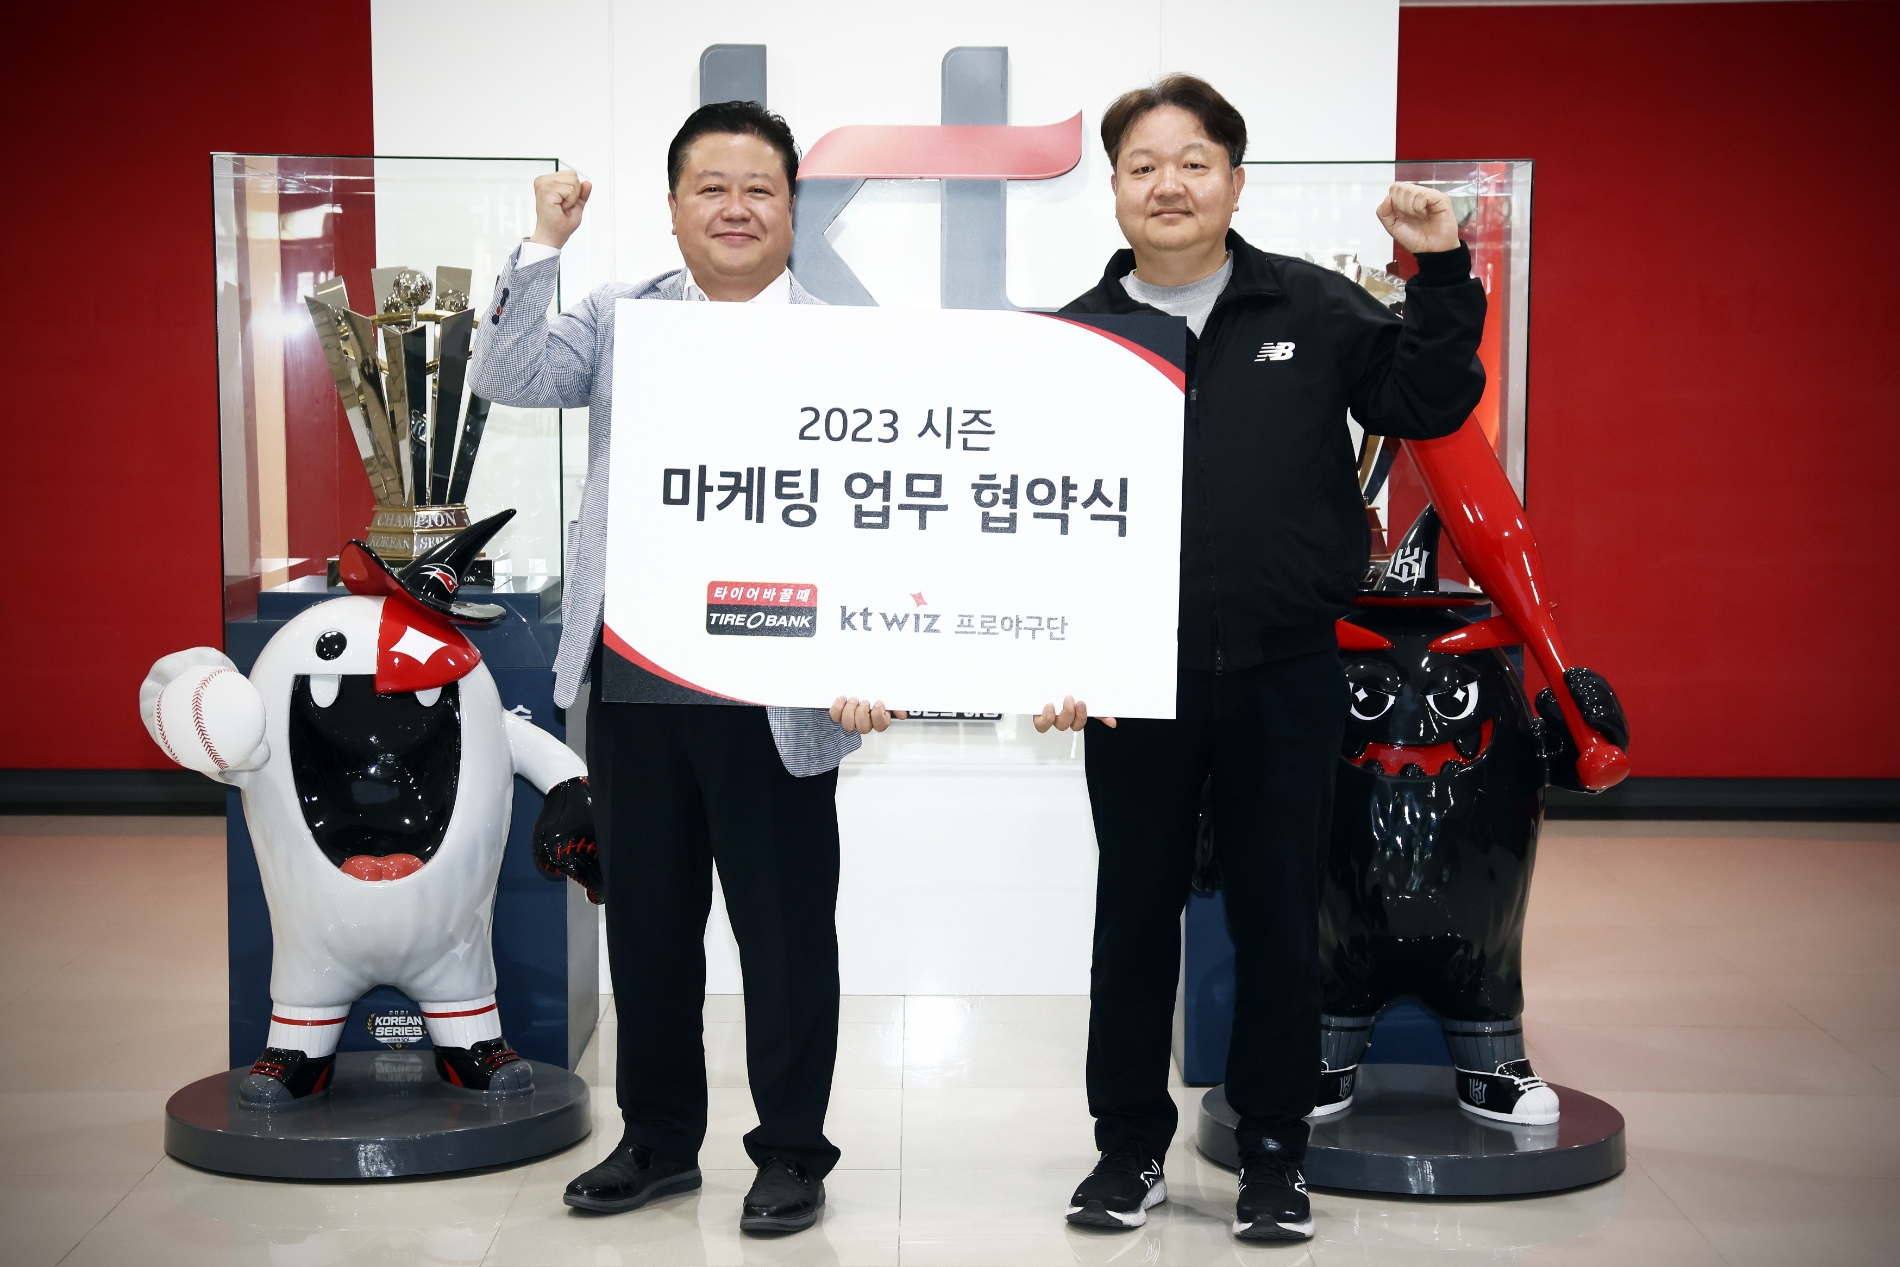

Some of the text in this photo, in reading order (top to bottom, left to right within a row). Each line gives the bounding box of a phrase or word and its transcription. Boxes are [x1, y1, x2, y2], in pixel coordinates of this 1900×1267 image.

[798, 406, 996, 452] 2023 시즌
[662, 464, 1128, 538] 마케팅 업무 협약식
[377, 511, 457, 529] CHAMPION
[840, 591, 1069, 641] kt wiz 프로야구단
[374, 1016, 423, 1026] KOREAN
[374, 1026, 423, 1036] SERIES
